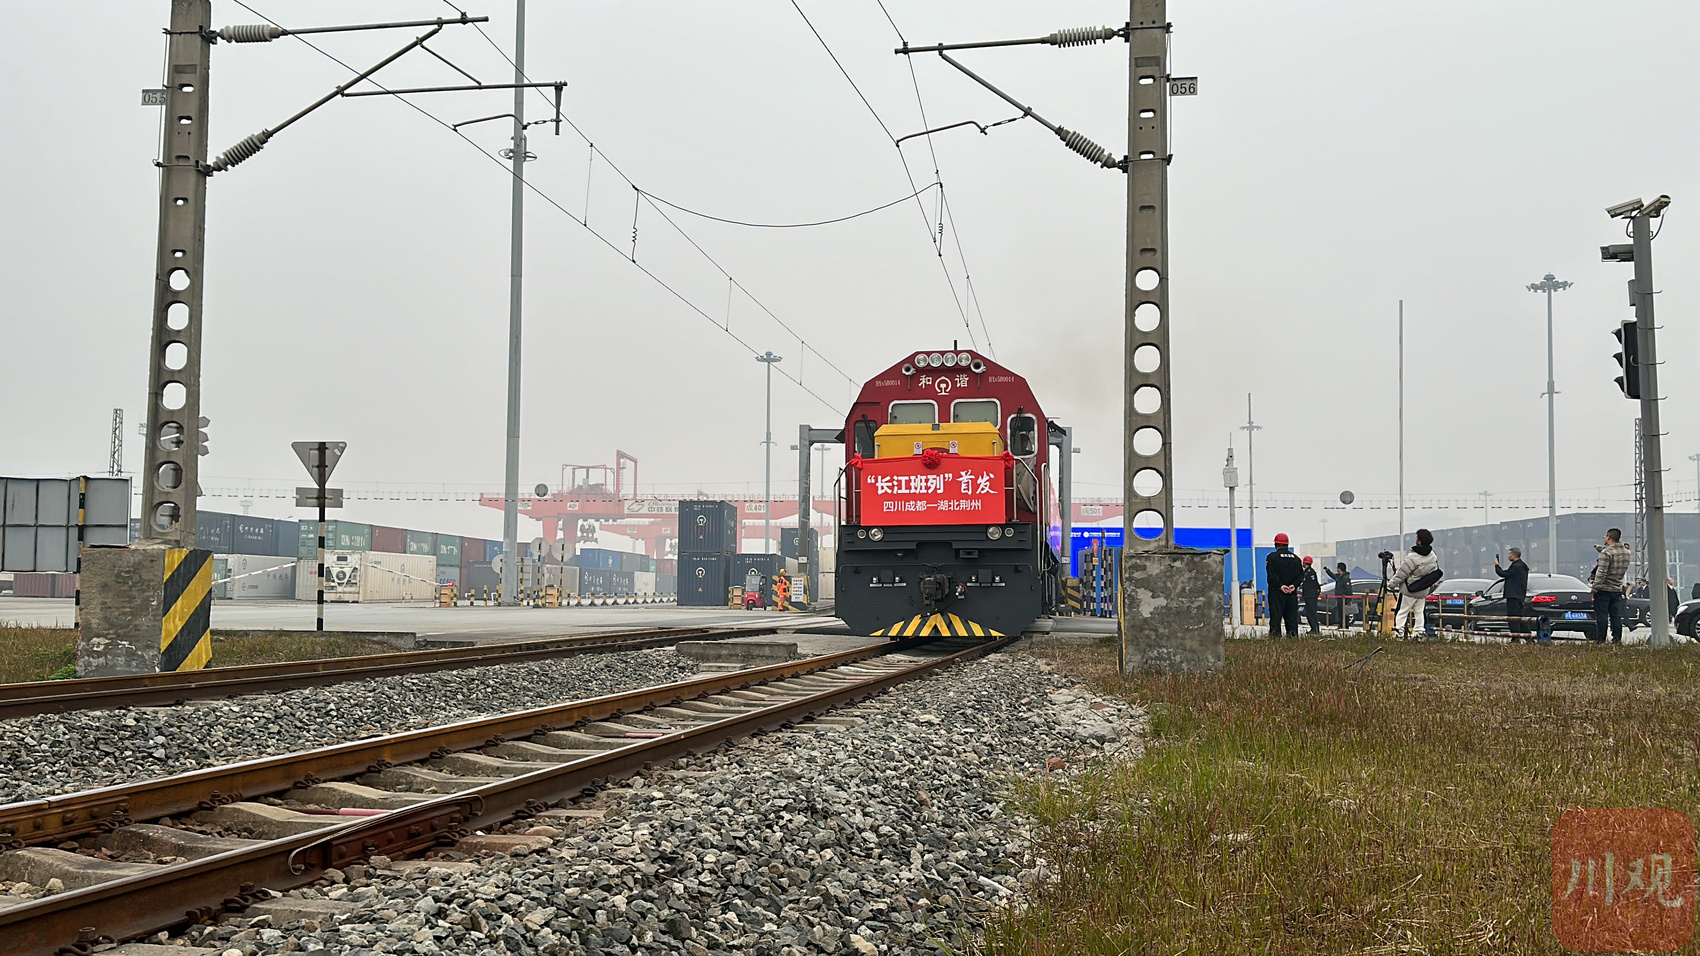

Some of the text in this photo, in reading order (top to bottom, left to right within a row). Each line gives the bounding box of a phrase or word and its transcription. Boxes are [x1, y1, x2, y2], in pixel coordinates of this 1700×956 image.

[1171, 82, 1196, 95] 056
[143, 93, 166, 104] 055
[918, 373, 969, 389] 和 谐
